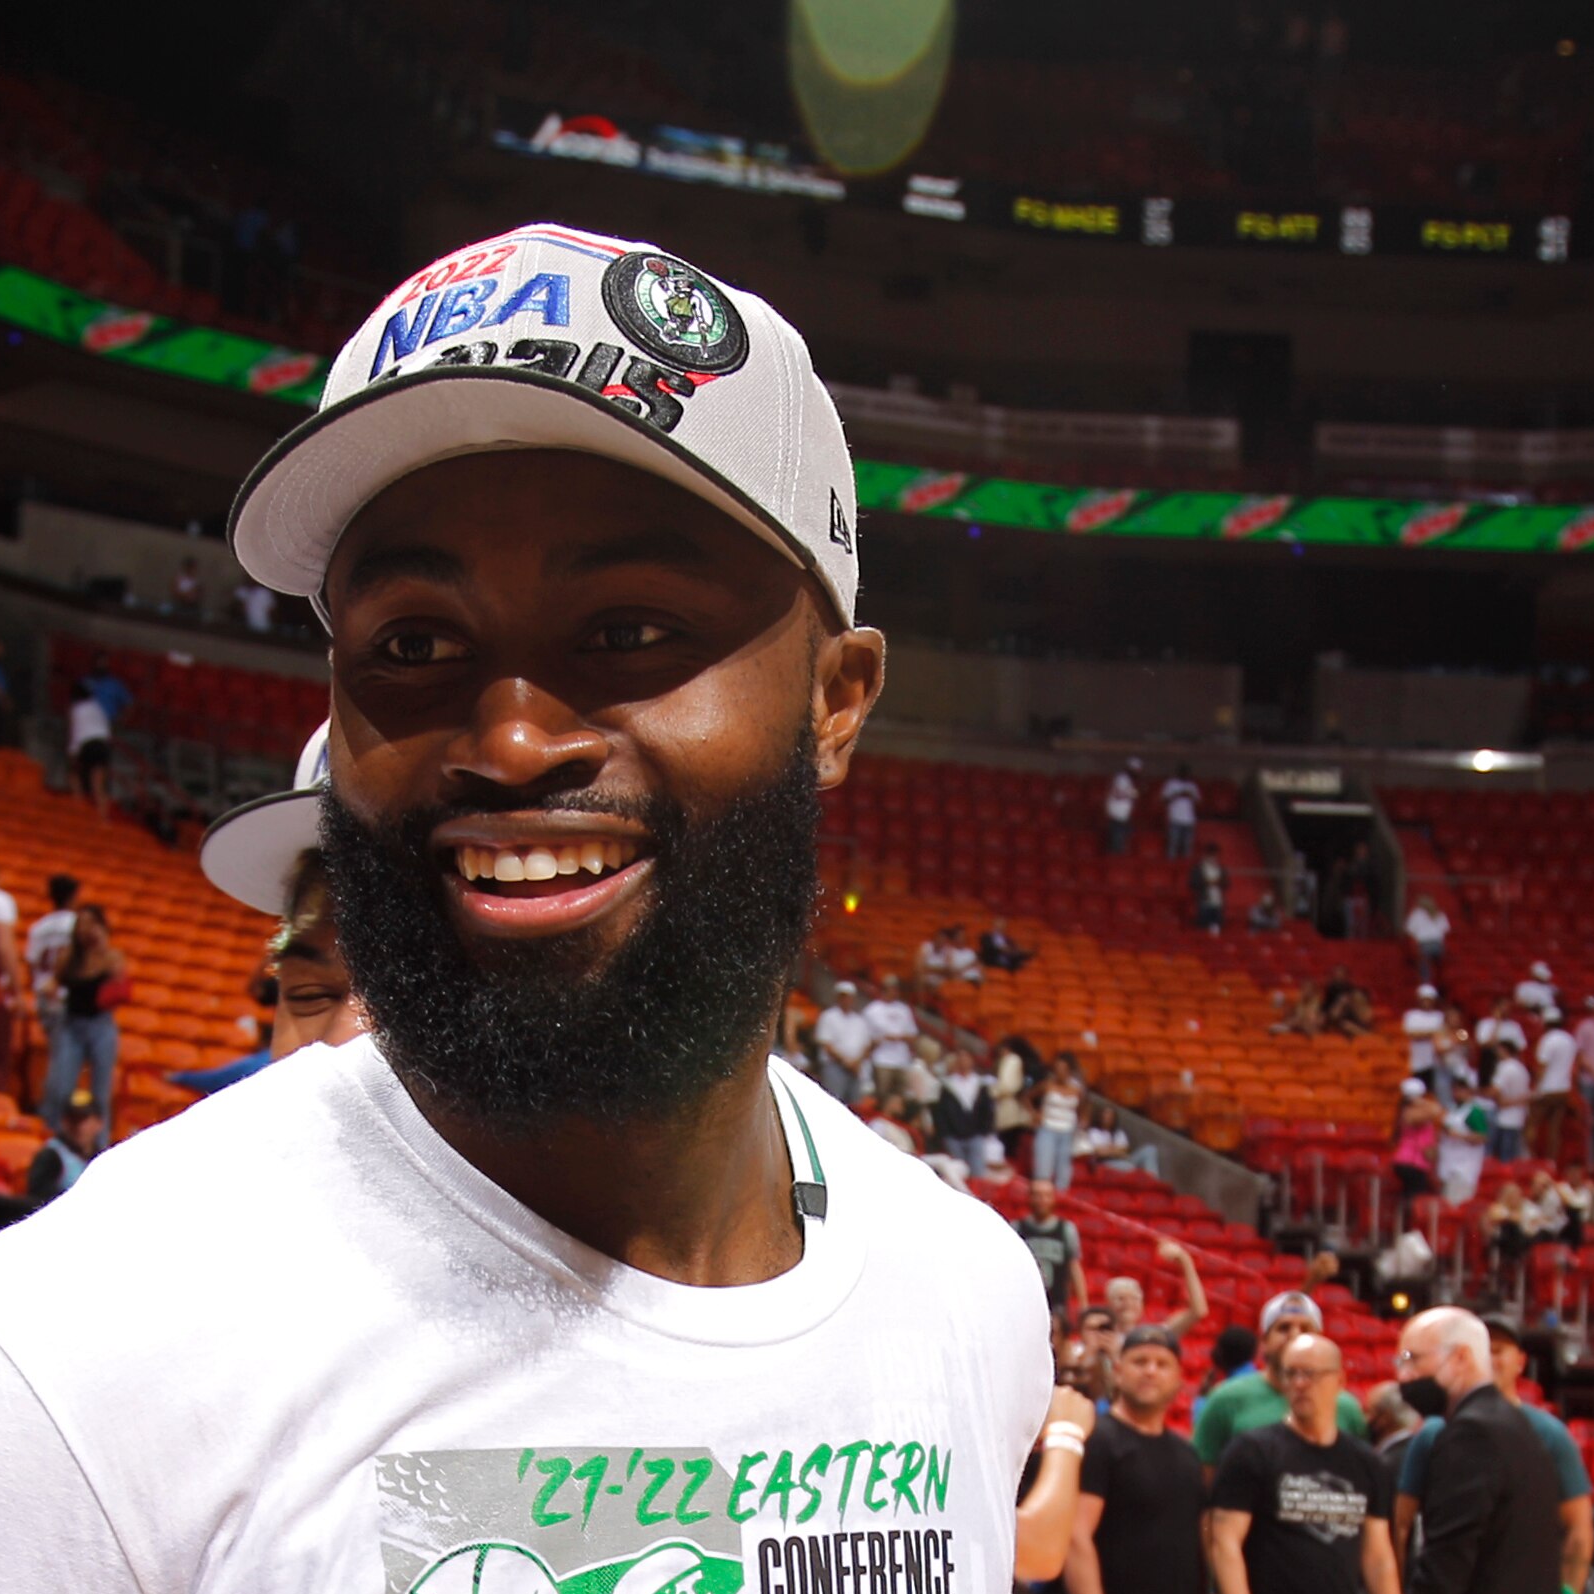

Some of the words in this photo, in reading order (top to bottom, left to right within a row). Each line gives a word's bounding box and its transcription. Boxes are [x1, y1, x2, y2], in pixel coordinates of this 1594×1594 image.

[398, 245, 517, 307] 2022
[368, 273, 570, 383] NBA
[518, 1448, 713, 1532] '21-'22
[725, 1440, 953, 1530] EASTERN
